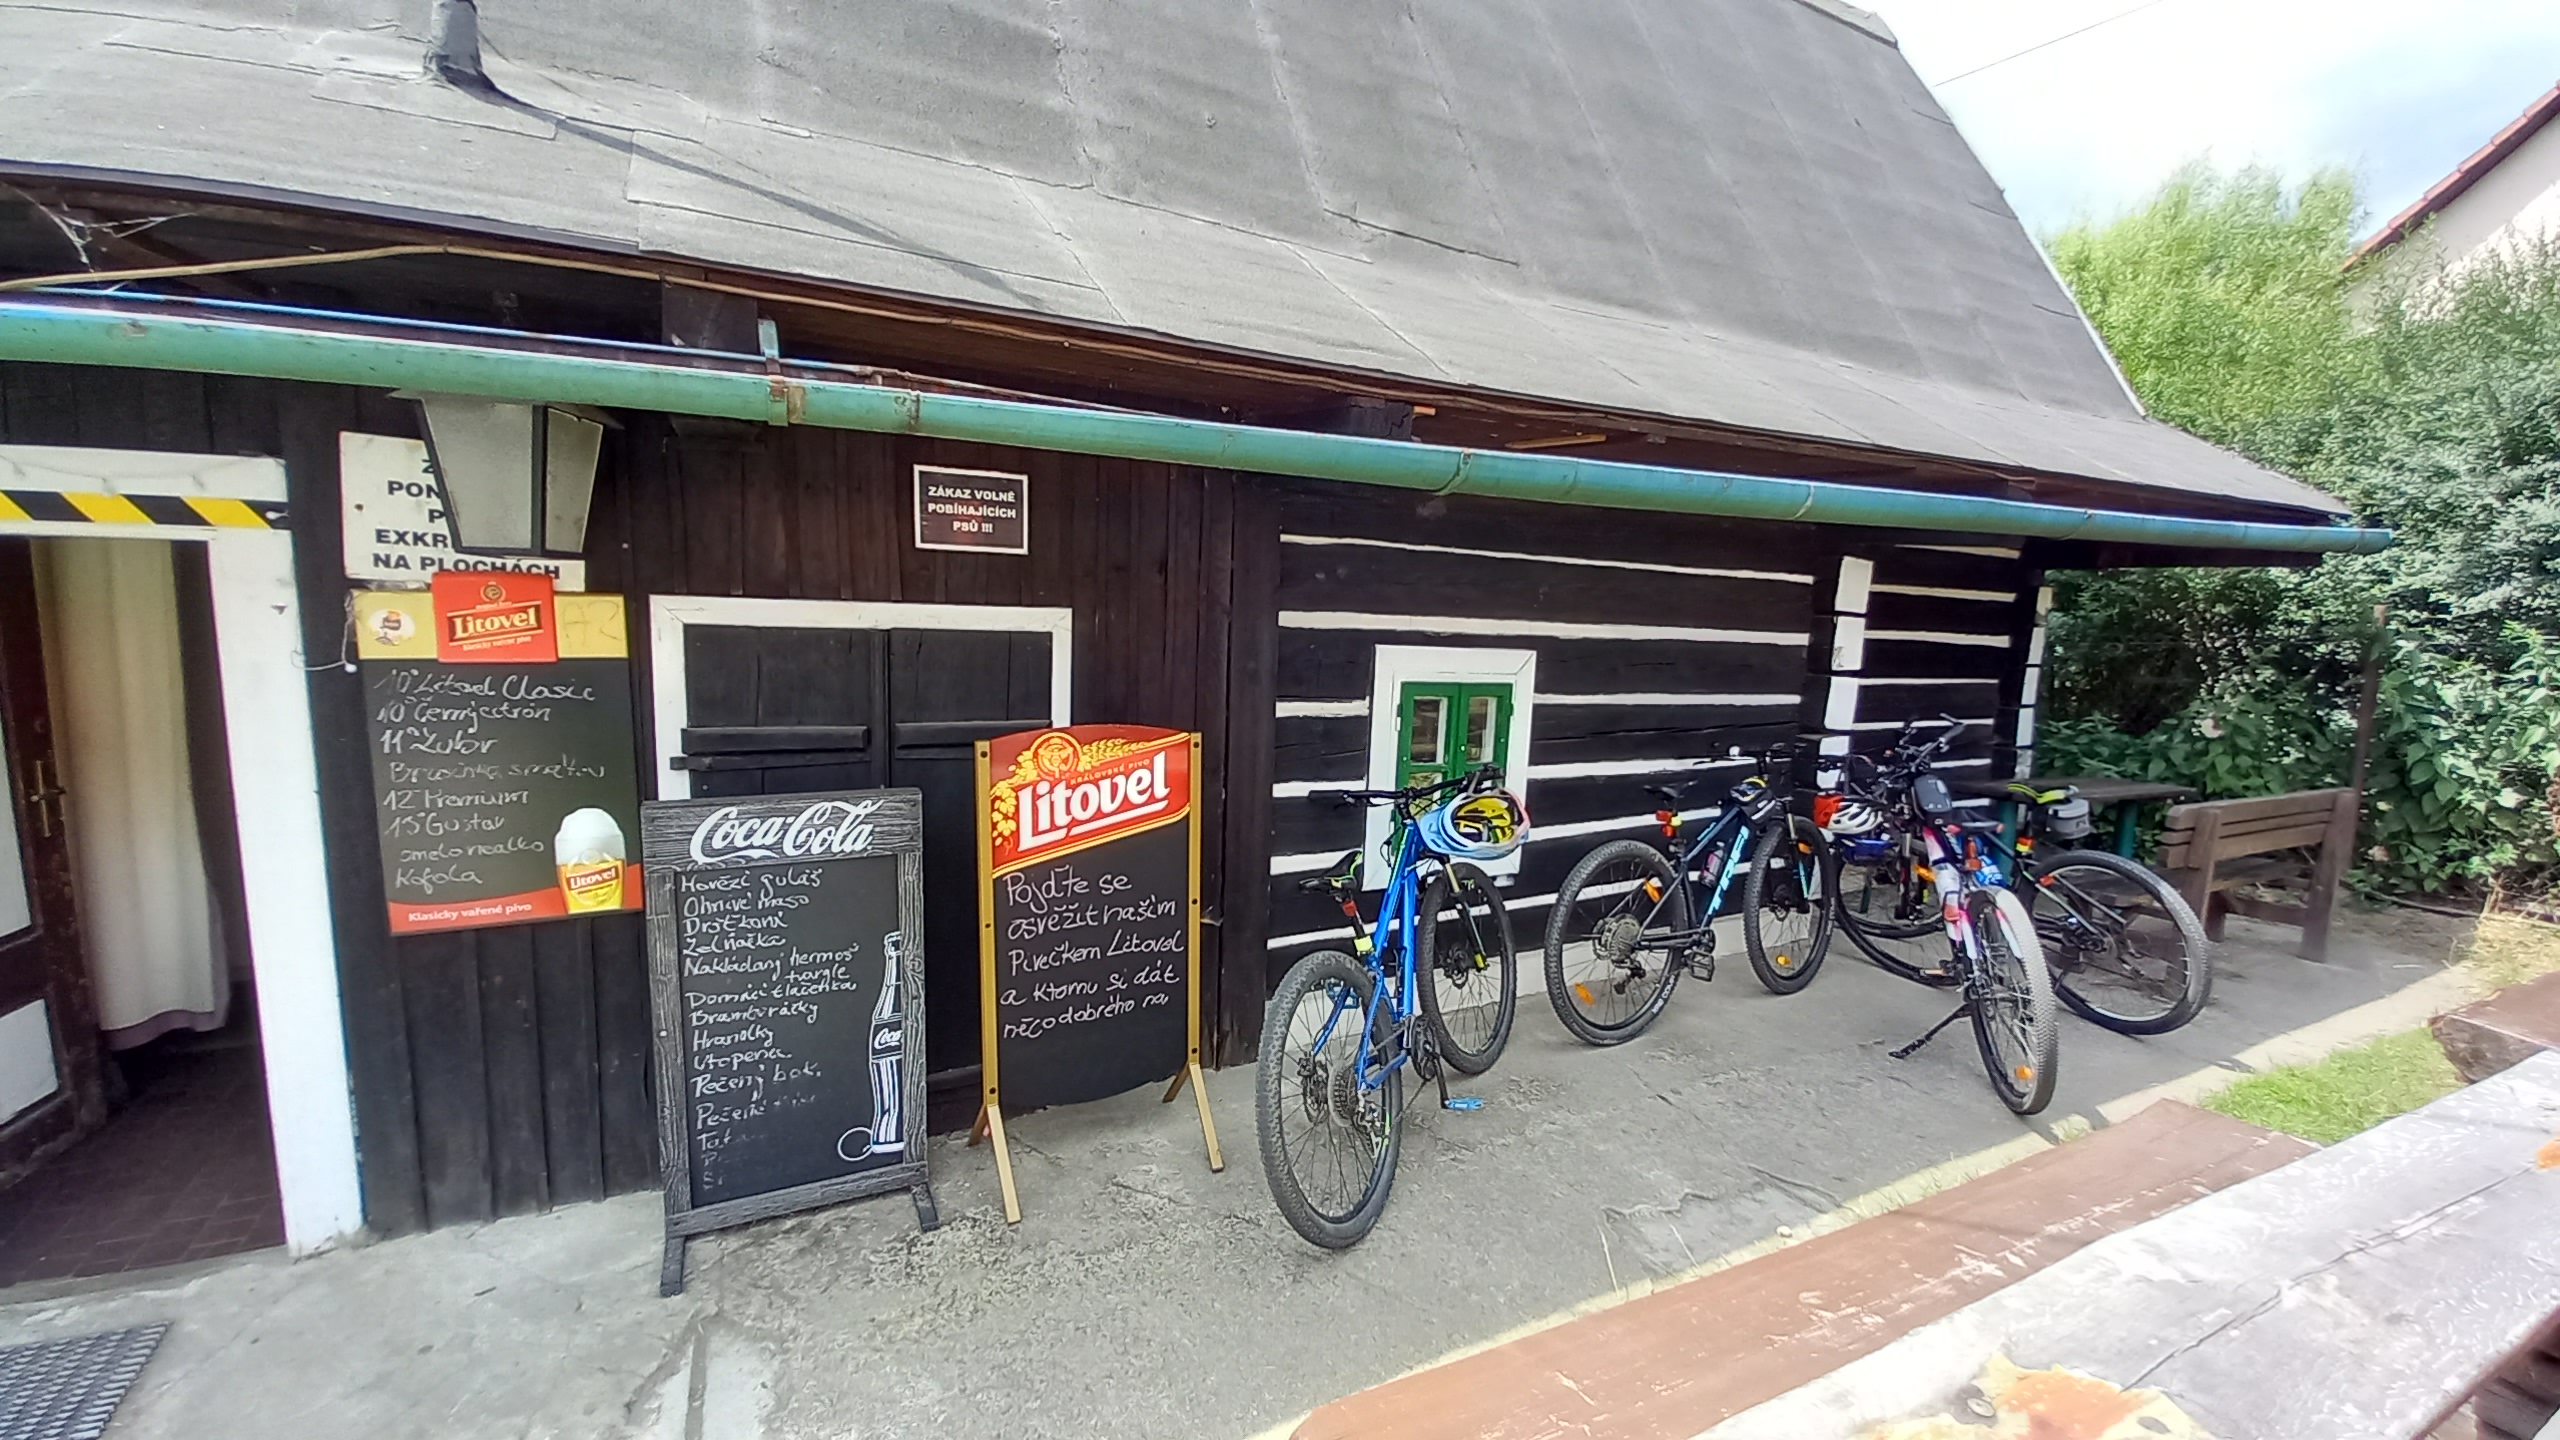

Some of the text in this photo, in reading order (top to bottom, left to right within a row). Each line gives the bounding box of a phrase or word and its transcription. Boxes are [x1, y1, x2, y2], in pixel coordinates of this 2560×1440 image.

[927, 485, 1016, 502] ZÁKAZ VOLNĚ
[927, 502, 1017, 518] POBÍHAJÍCÍCH
[952, 519, 994, 533] PSŮ !!!
[373, 553, 411, 570] NA
[453, 607, 537, 640] Litovel
[1069, 758, 1151, 786] KRÁLOVSKÉ PIVO
[1017, 750, 1172, 852] Litovel
[689, 799, 885, 865] Coca-Cola
[1098, 873, 1133, 894] se
[408, 902, 532, 922] Klasicky vařené pivo
[1007, 902, 1099, 940] osvěžit
[1000, 990, 1028, 1006] a
[1106, 968, 1129, 991] si
[1133, 960, 1181, 986] dát
[1058, 993, 1136, 1025] dobrého
[692, 1024, 775, 1053] Hranolky
